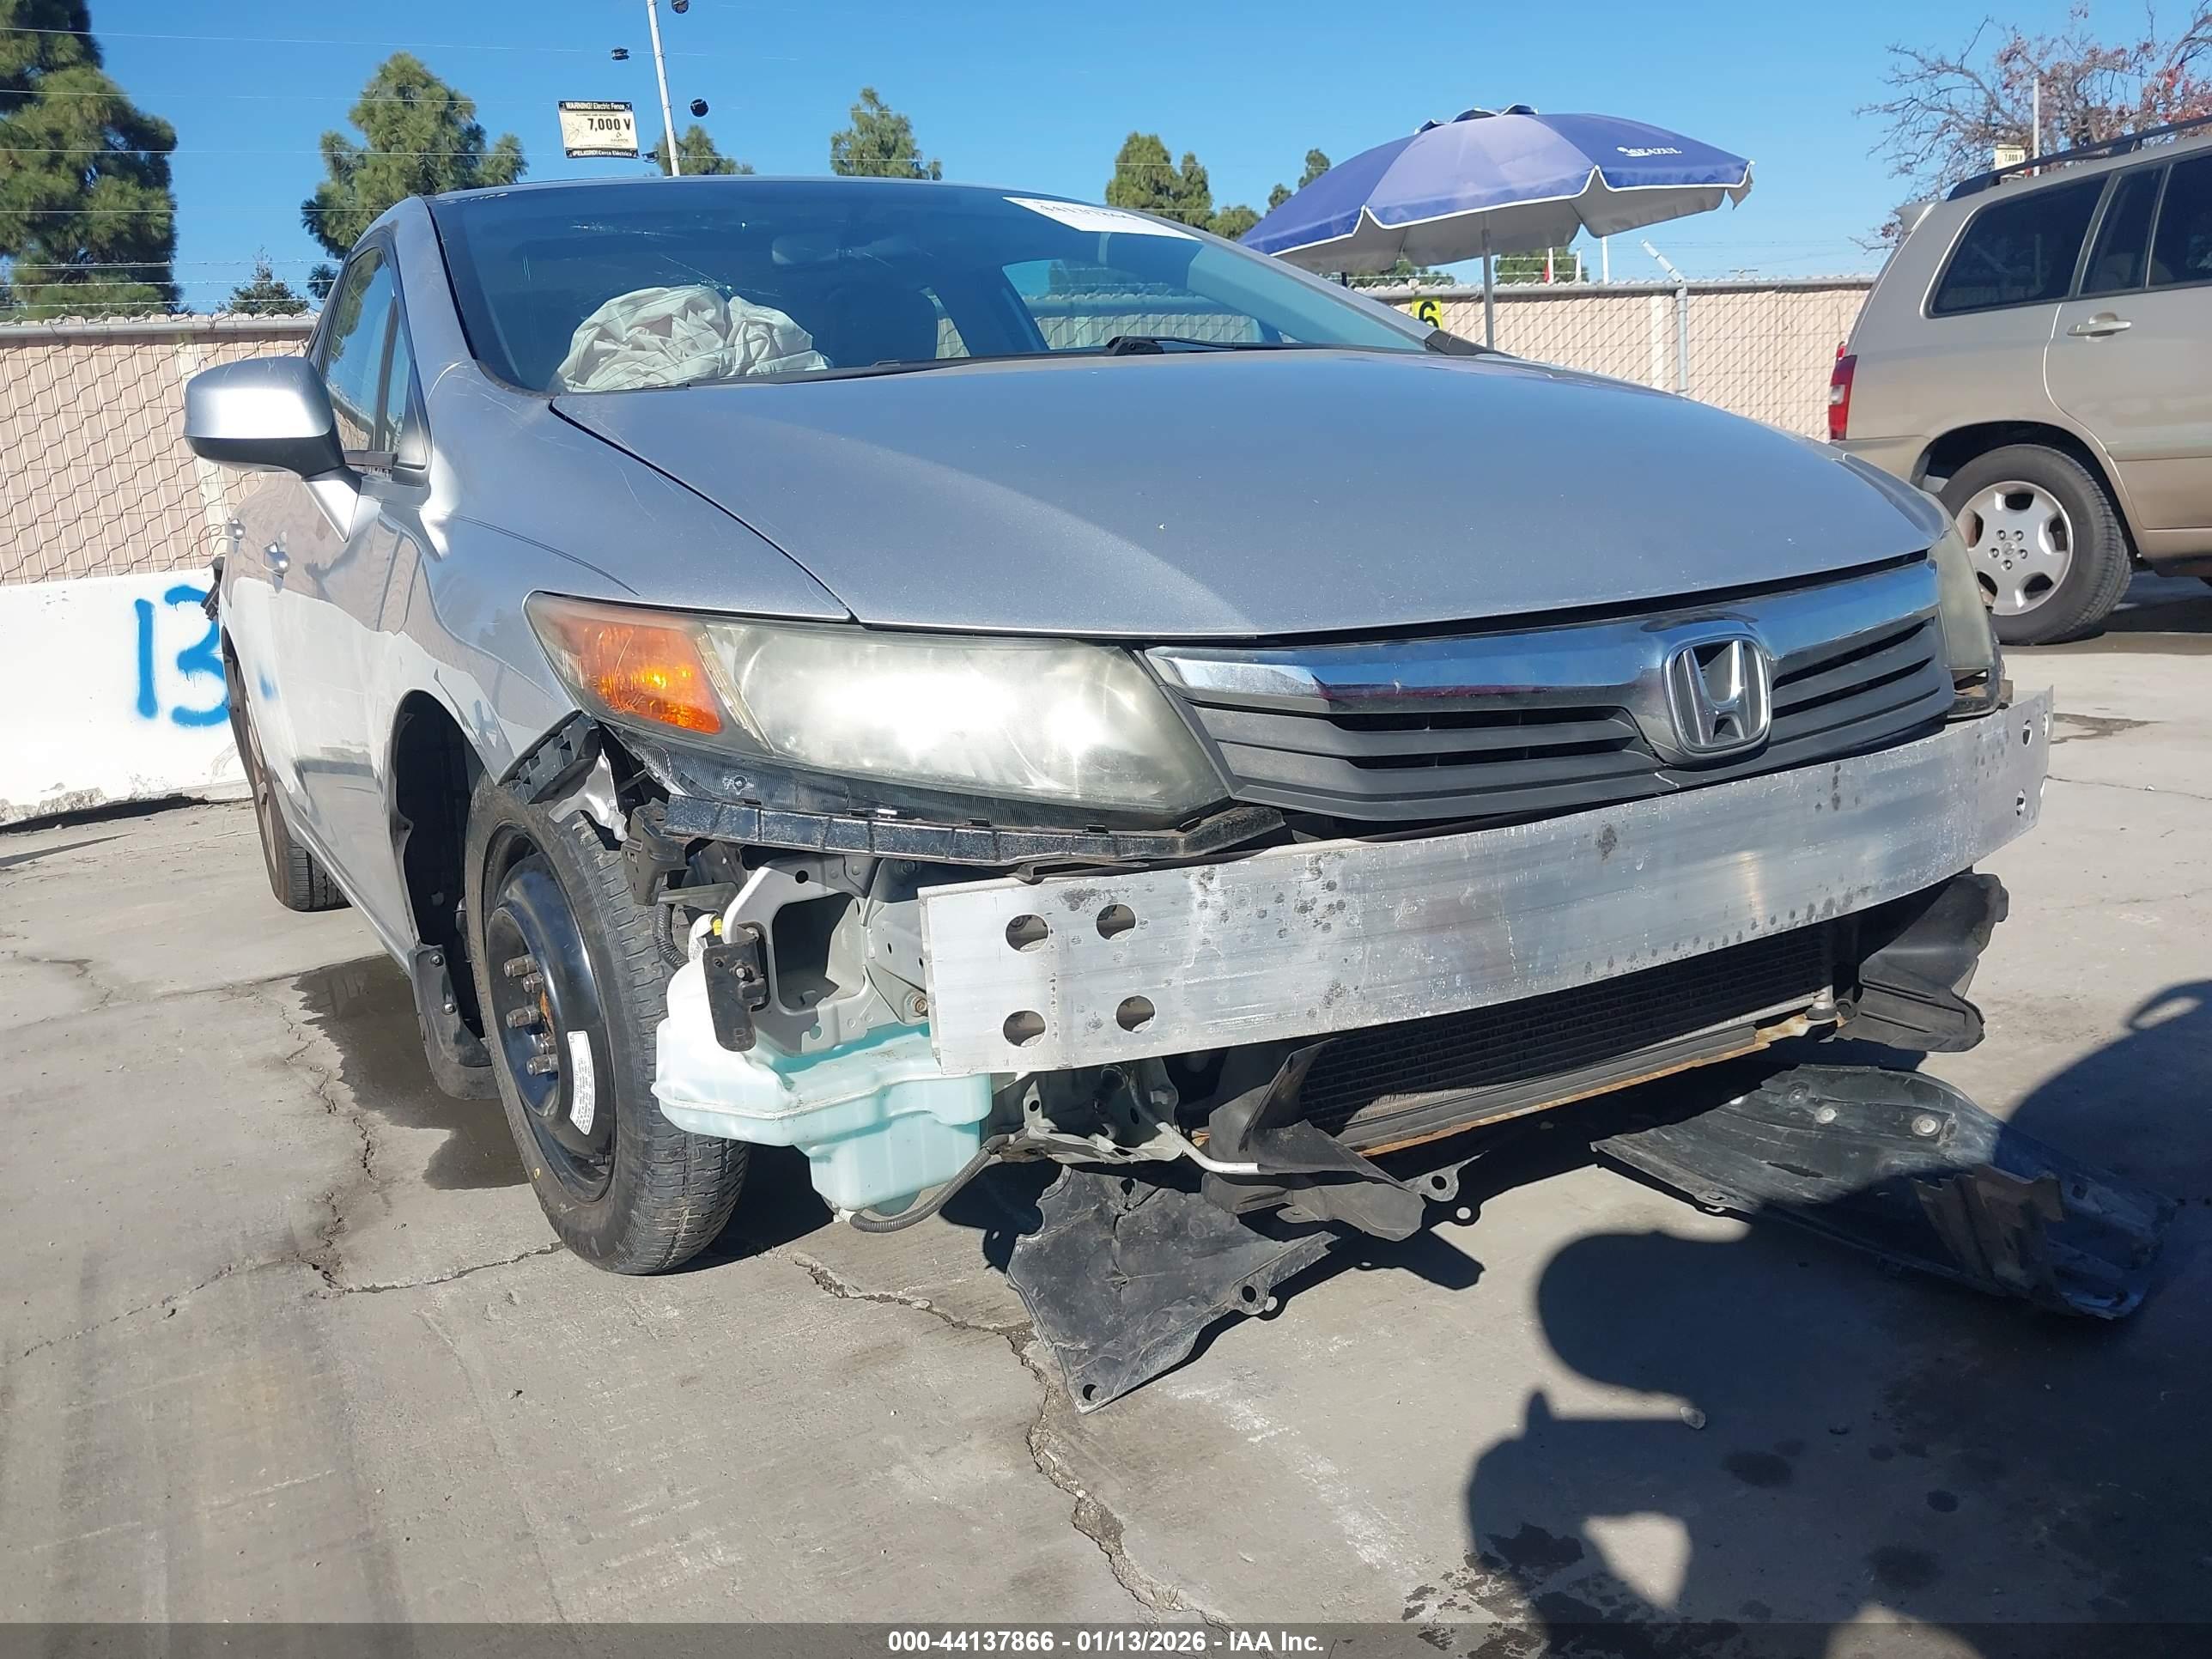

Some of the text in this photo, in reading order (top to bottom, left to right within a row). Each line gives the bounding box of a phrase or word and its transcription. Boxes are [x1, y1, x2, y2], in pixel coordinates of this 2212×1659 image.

[587, 118, 631, 132] 7,000 V
[1419, 301, 1439, 328] 6
[131, 584, 229, 727] 13
